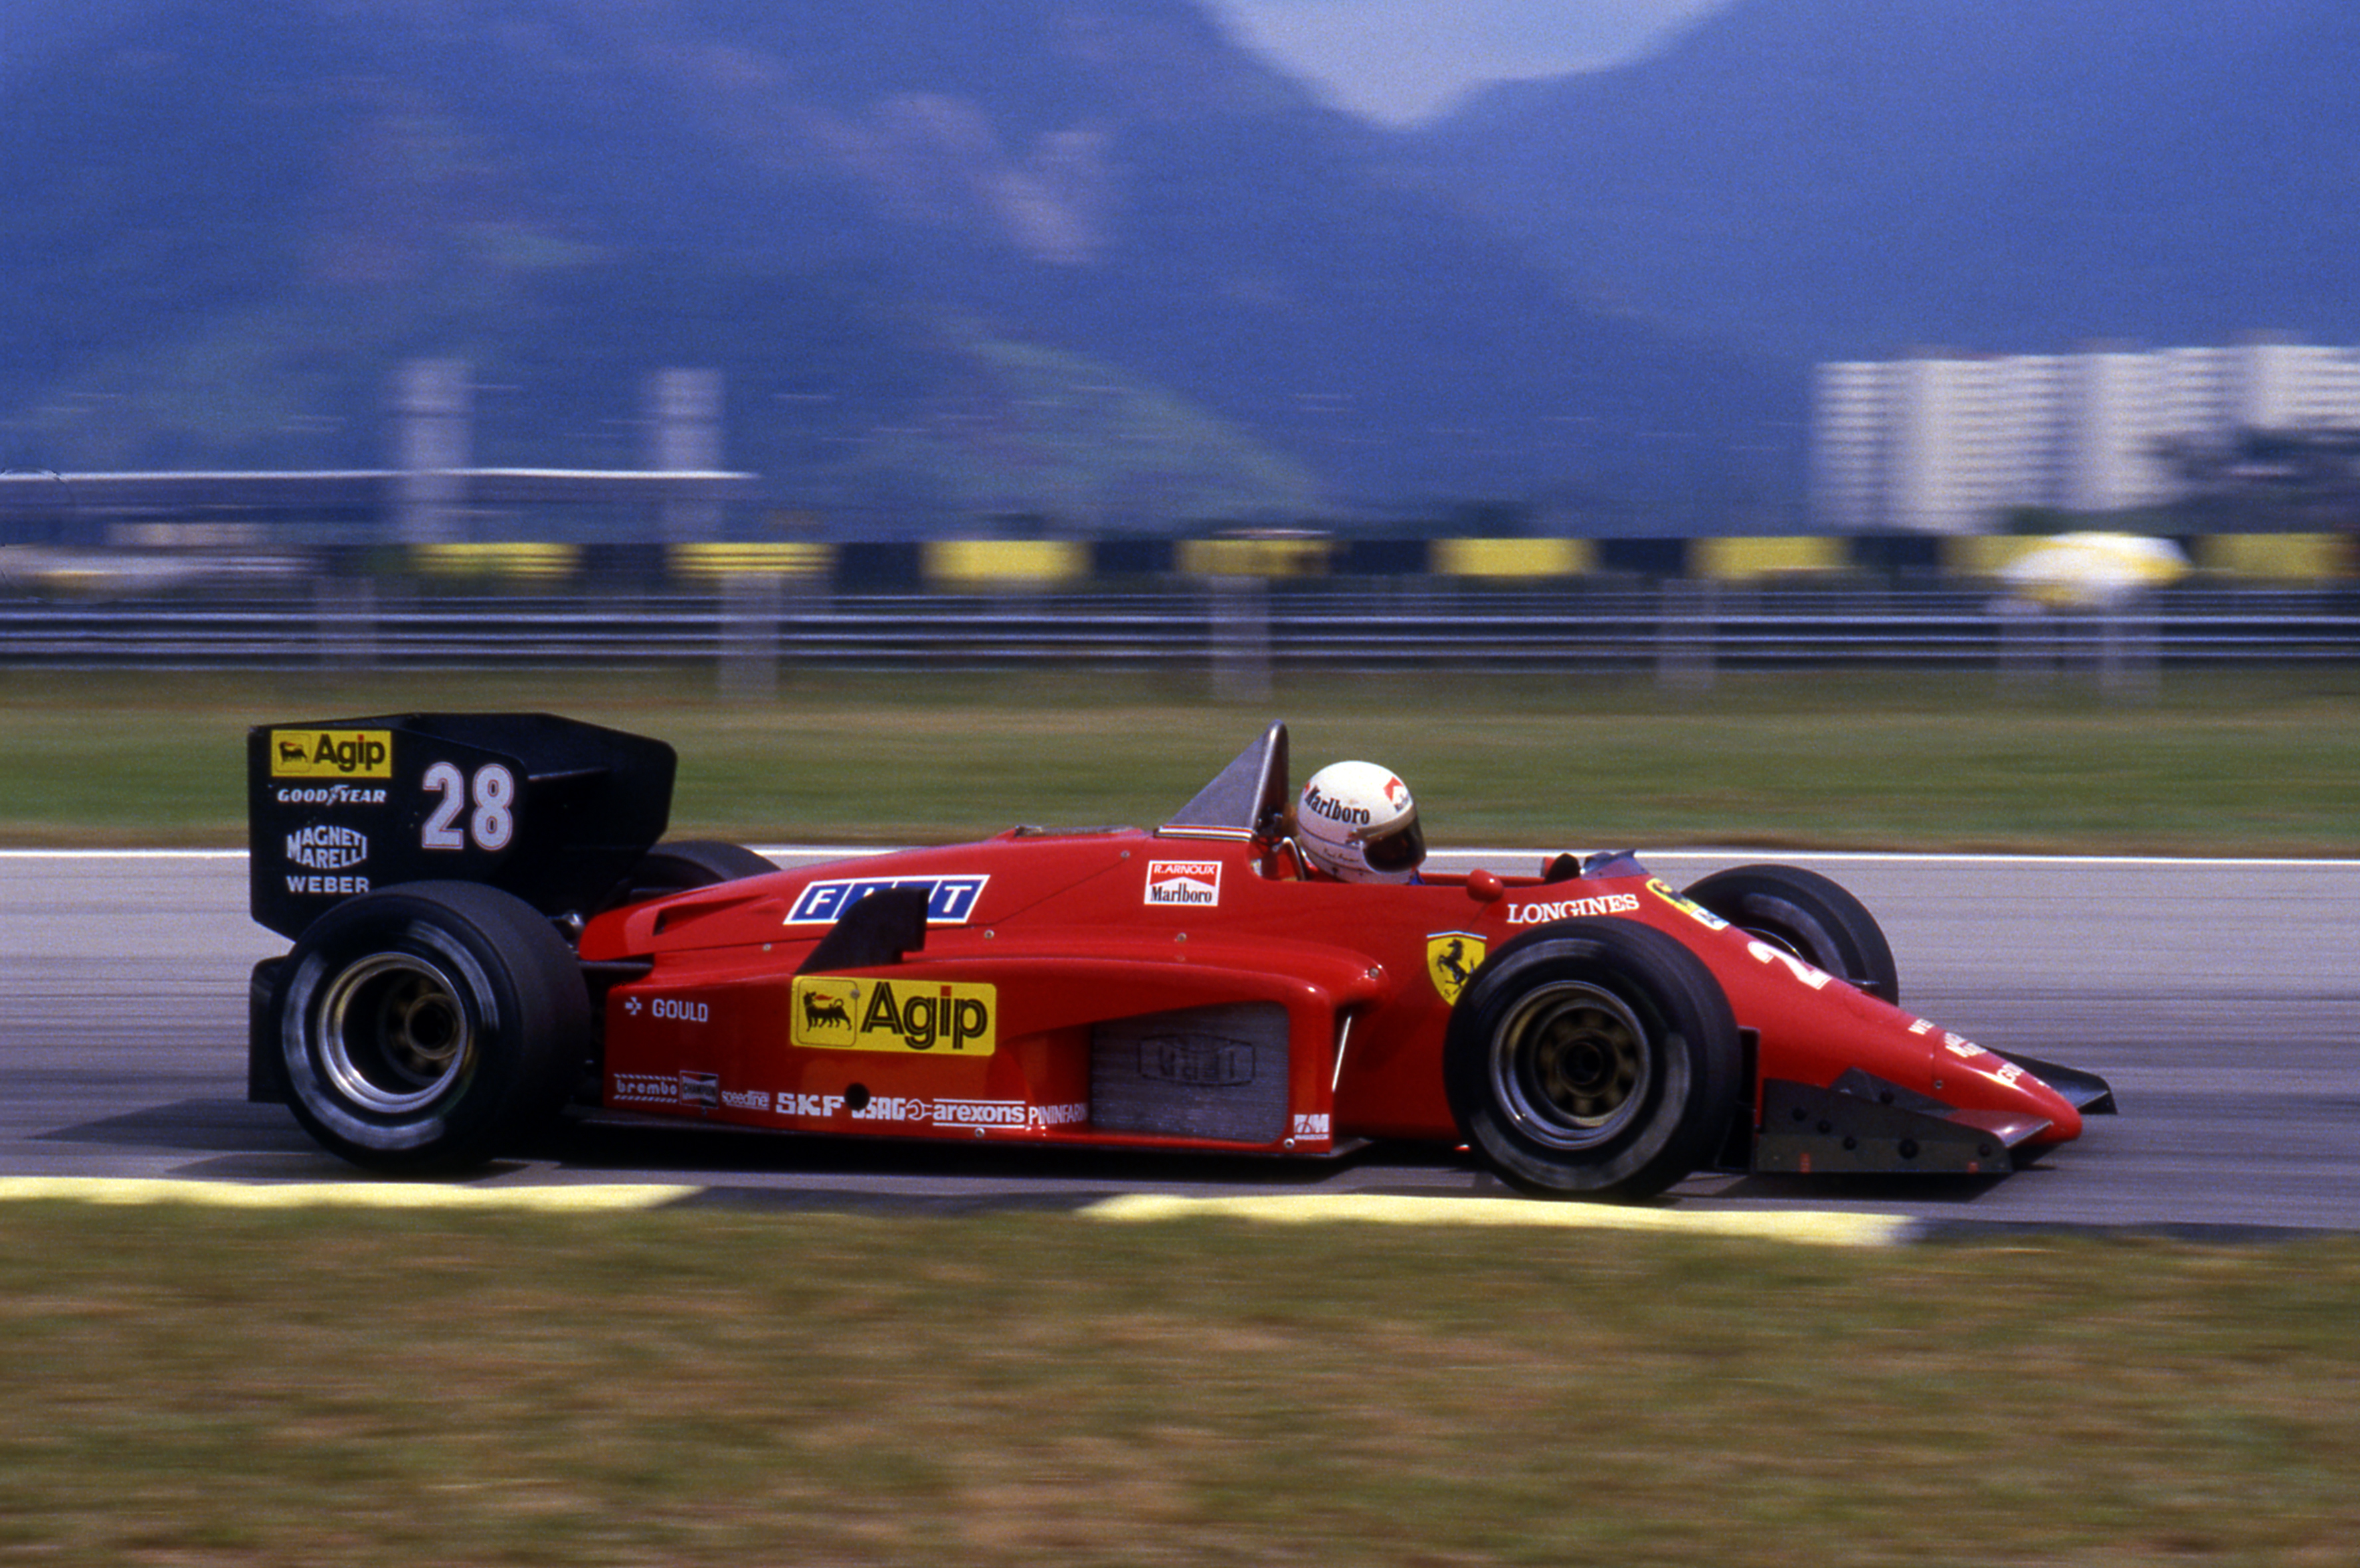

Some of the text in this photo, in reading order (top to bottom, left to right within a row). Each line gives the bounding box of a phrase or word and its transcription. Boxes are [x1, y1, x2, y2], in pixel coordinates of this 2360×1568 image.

[314, 733, 385, 772] Agip
[422, 762, 514, 851] 28
[286, 825, 367, 850] MAGNETI
[286, 843, 367, 869] MARELLI
[286, 875, 369, 893] WEBER
[1151, 883, 1212, 903] Marlboro
[806, 885, 972, 915] FT
[1506, 894, 1639, 923] LONGINES
[652, 998, 708, 1022] GOULD
[860, 981, 988, 1050] Agip
[616, 1079, 678, 1095] brembo
[776, 1092, 845, 1117] SKF
[933, 1103, 1025, 1122] arexons
